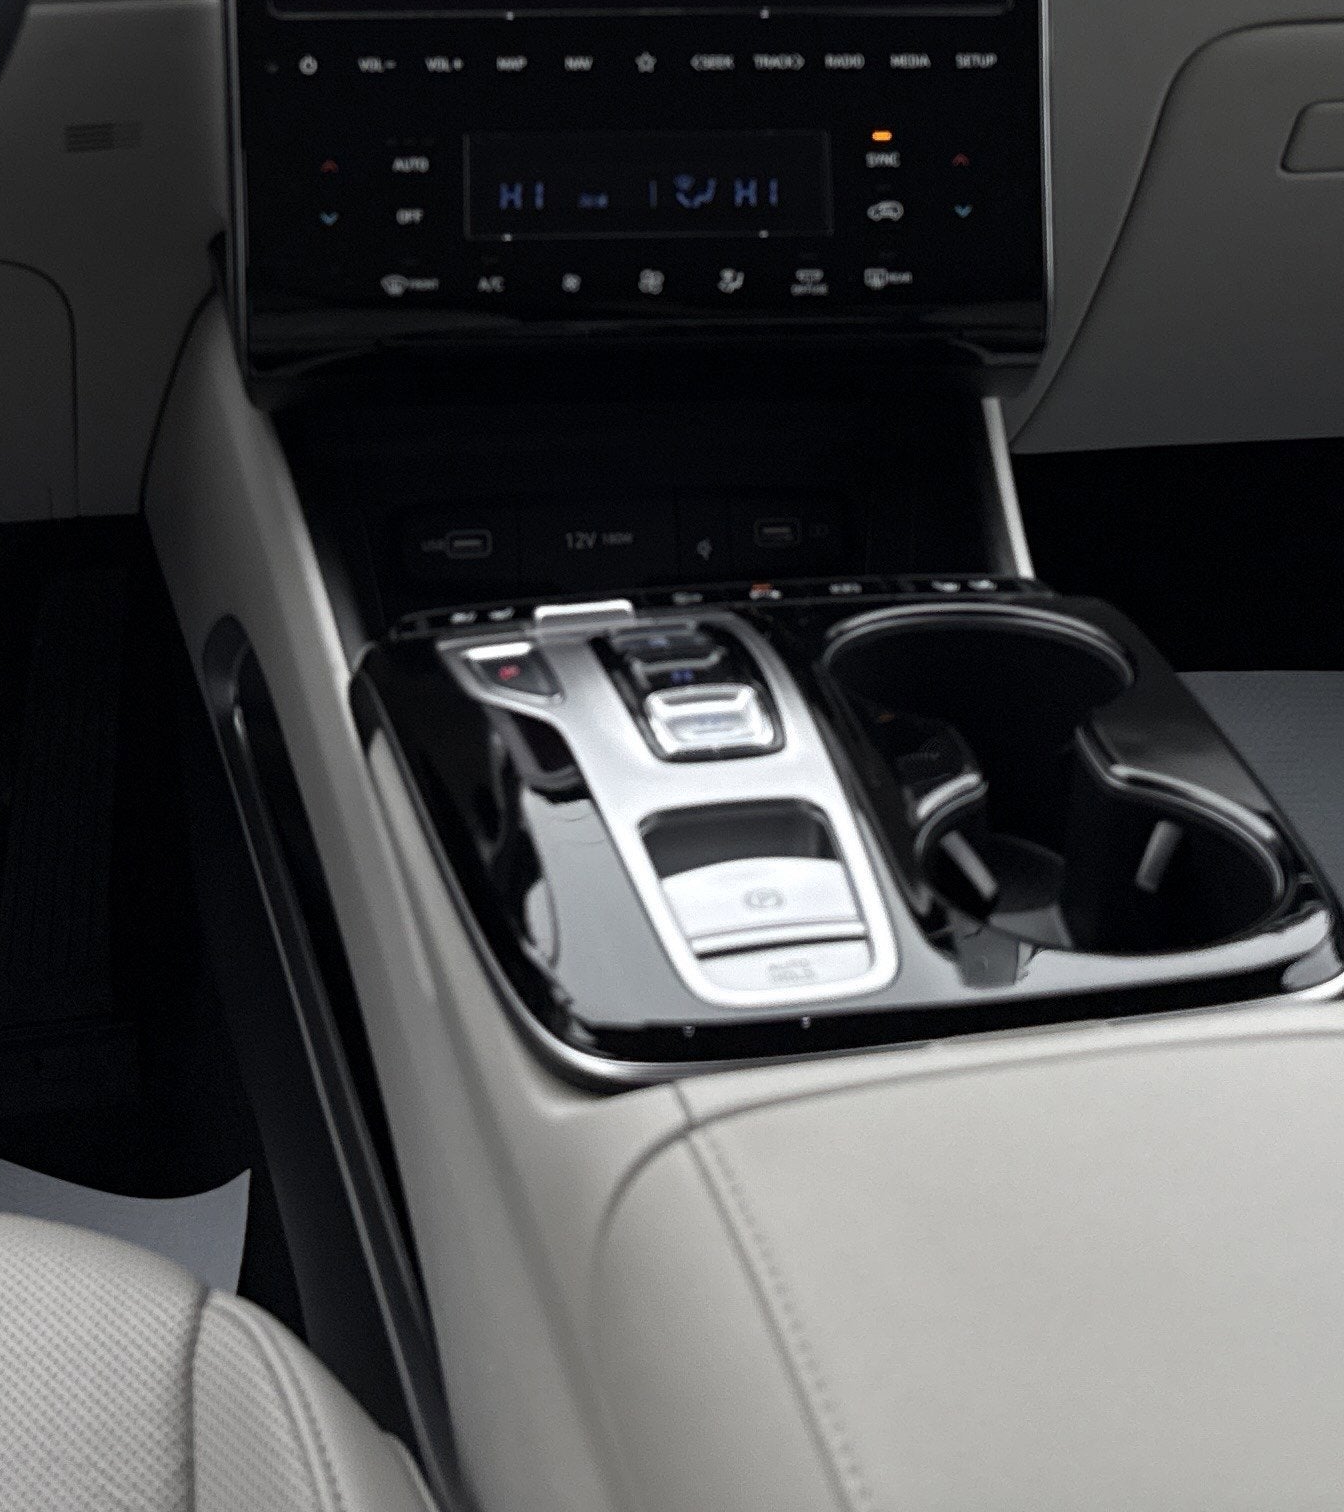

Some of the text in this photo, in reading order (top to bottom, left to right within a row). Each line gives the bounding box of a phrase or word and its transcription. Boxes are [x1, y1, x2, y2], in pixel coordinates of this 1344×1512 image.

[824, 54, 865, 69] RADIO
[890, 54, 931, 68] MEDIA
[955, 53, 998, 68] SETUP
[392, 156, 430, 172] AUTO
[866, 151, 901, 168] SYNC
[499, 182, 545, 209] HI
[734, 179, 778, 206] HI
[396, 208, 423, 225] OFF
[565, 531, 597, 550] 12V
